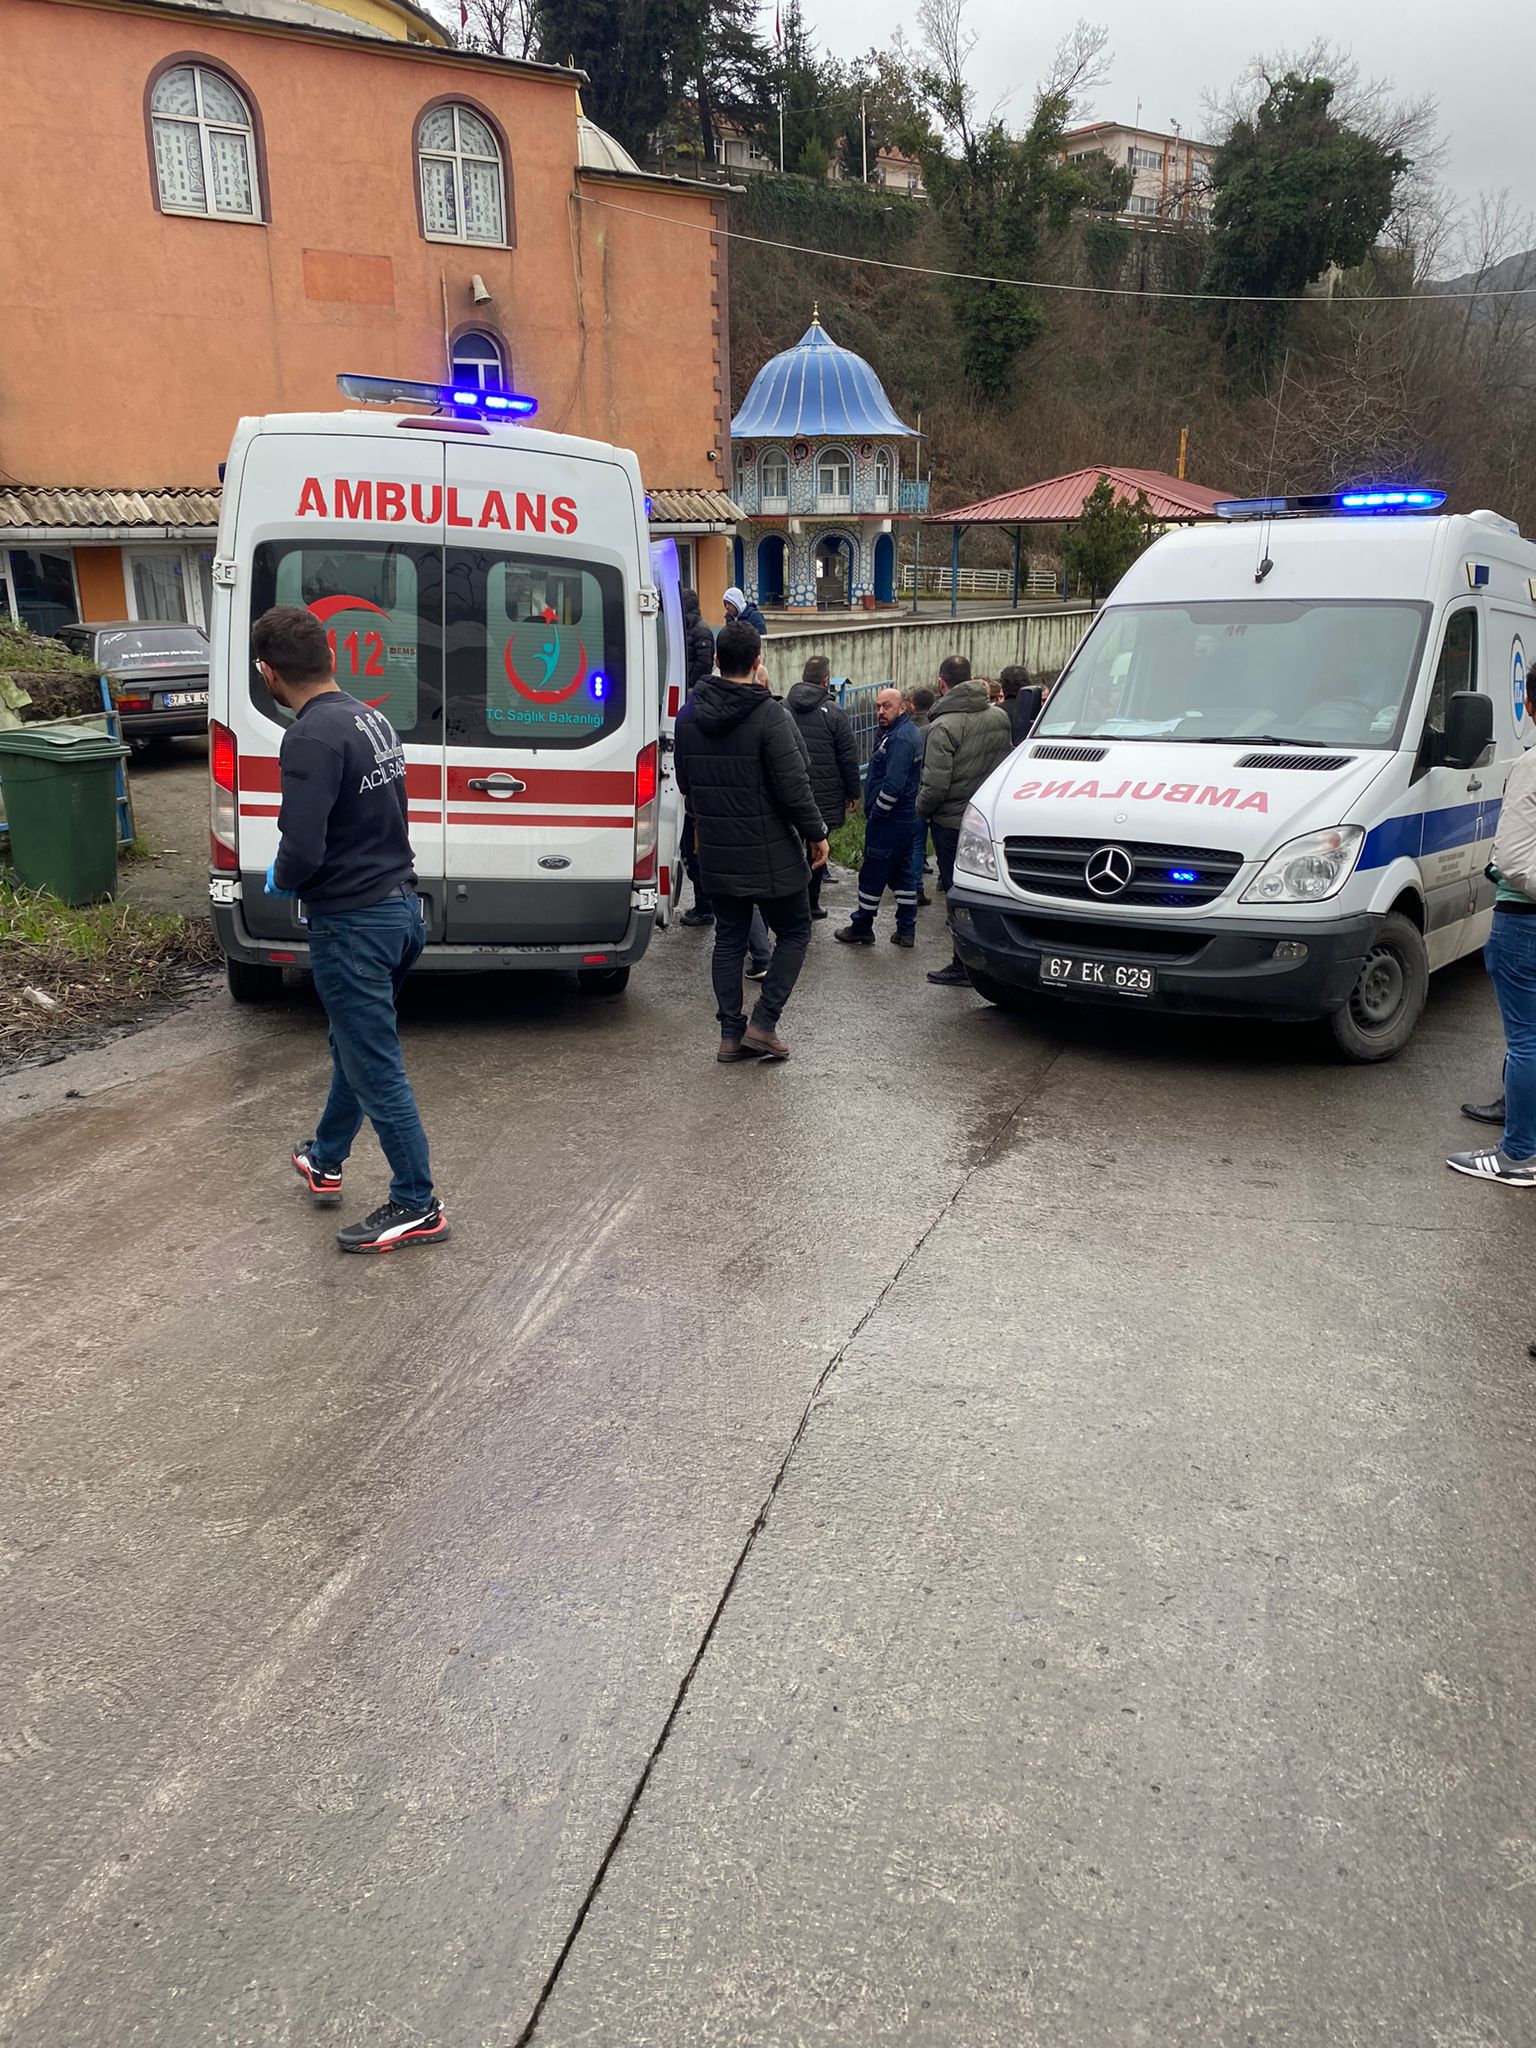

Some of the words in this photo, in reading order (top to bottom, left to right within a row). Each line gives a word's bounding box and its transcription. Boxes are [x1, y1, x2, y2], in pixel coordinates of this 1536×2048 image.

[295, 477, 578, 534] AMBULANS
[507, 709, 545, 725] Sağlık
[549, 711, 604, 728] Bakanlığı
[1050, 958, 1072, 977] 67
[1082, 962, 1105, 982] EK
[1115, 966, 1151, 989] 629
